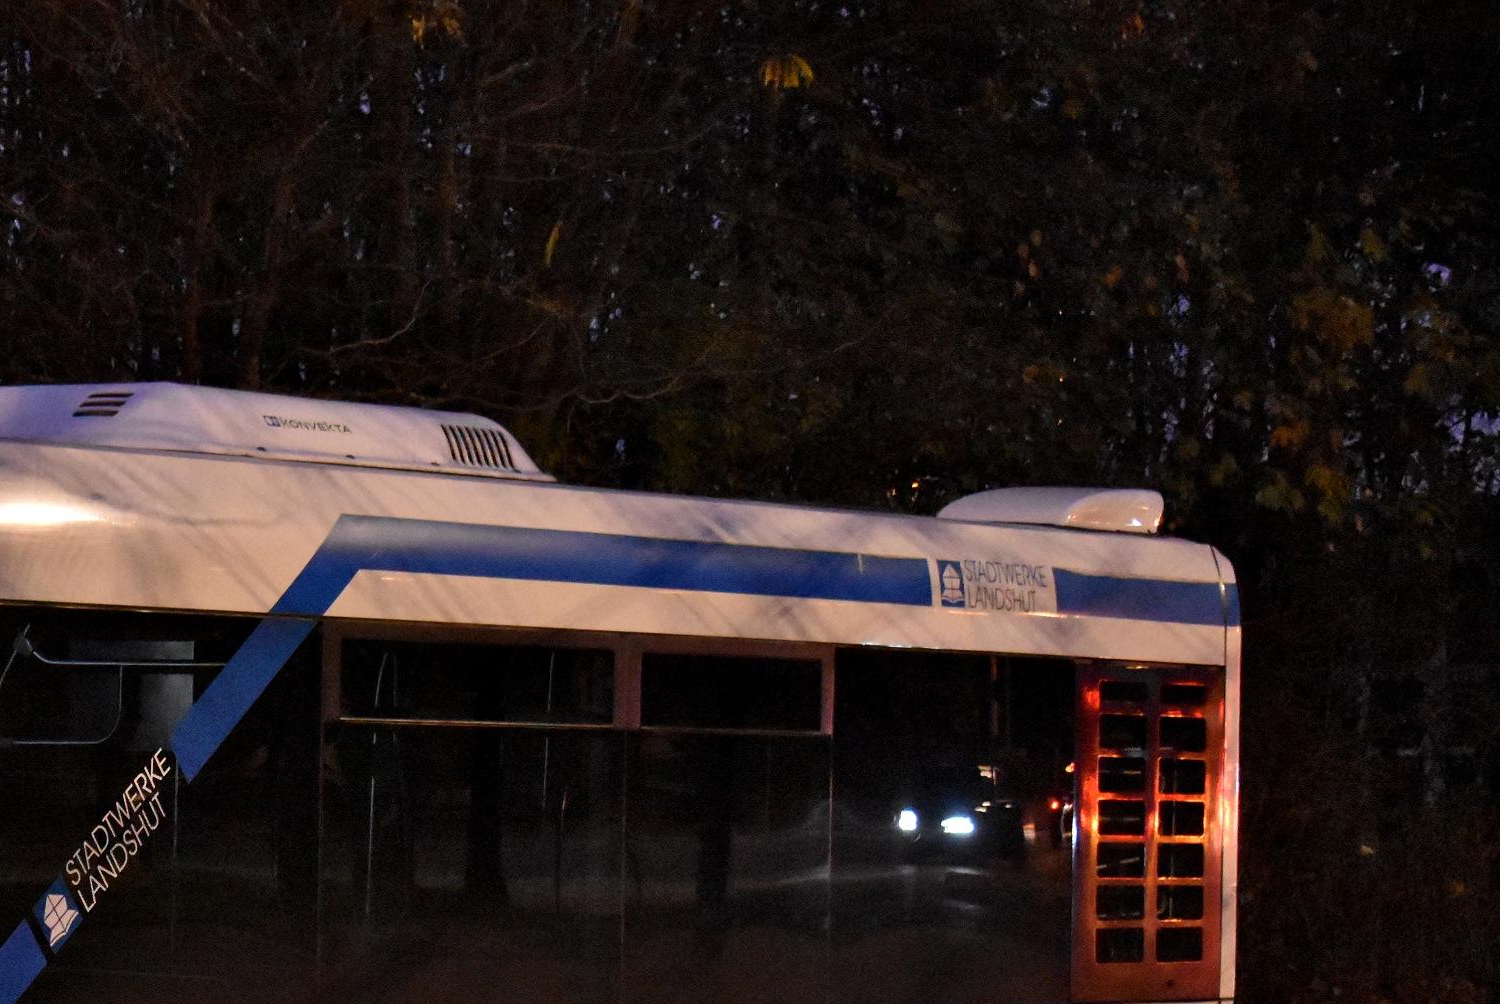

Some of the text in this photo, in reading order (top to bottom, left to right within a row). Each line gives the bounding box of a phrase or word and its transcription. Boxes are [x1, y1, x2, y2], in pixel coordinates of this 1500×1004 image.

[279, 418, 353, 434] KONVEKTA
[963, 559, 1048, 588] STADTWERKE
[967, 585, 1036, 612] LANDSHUT
[65, 747, 171, 886] STADTWERKE
[77, 791, 166, 913] LANDSHUT
